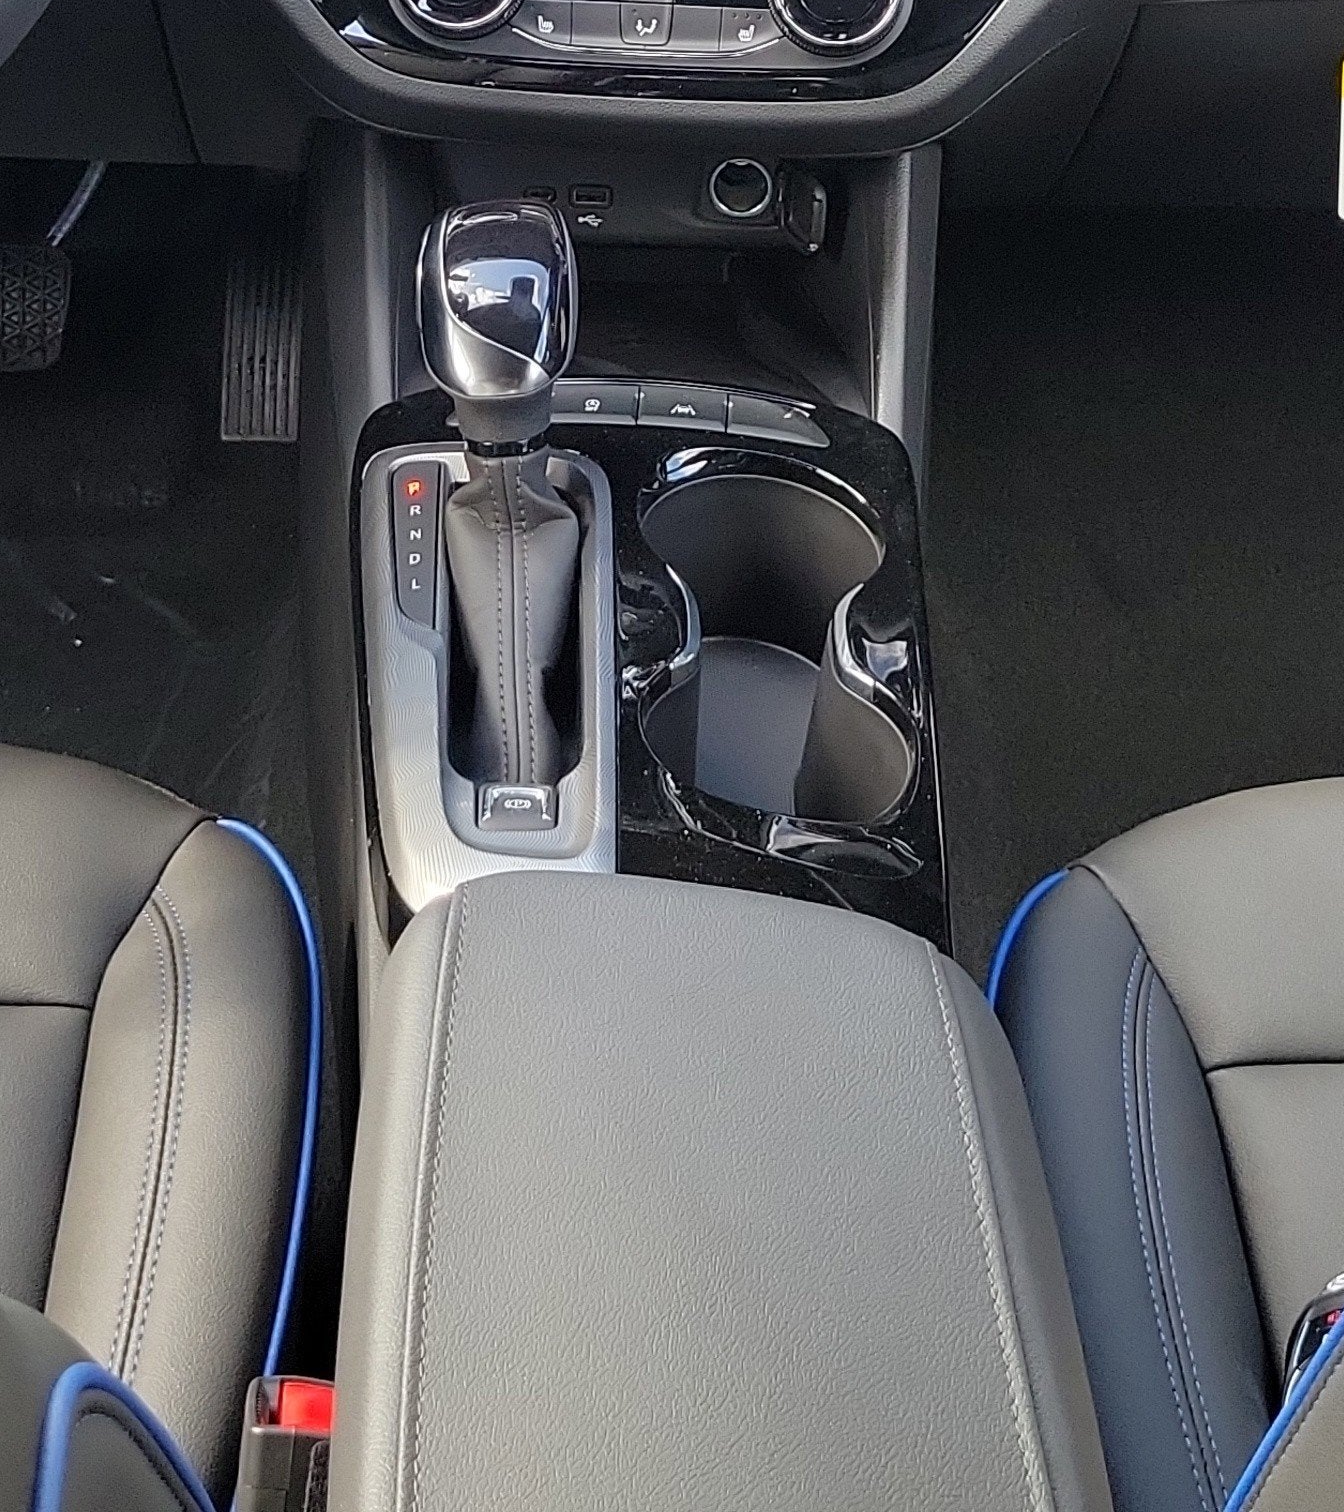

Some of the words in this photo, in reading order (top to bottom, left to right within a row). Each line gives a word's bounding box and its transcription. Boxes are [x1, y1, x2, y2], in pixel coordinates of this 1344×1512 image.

[409, 504, 422, 517] R
[409, 528, 422, 541] N
[408, 553, 421, 565] D
[411, 578, 421, 590] L
